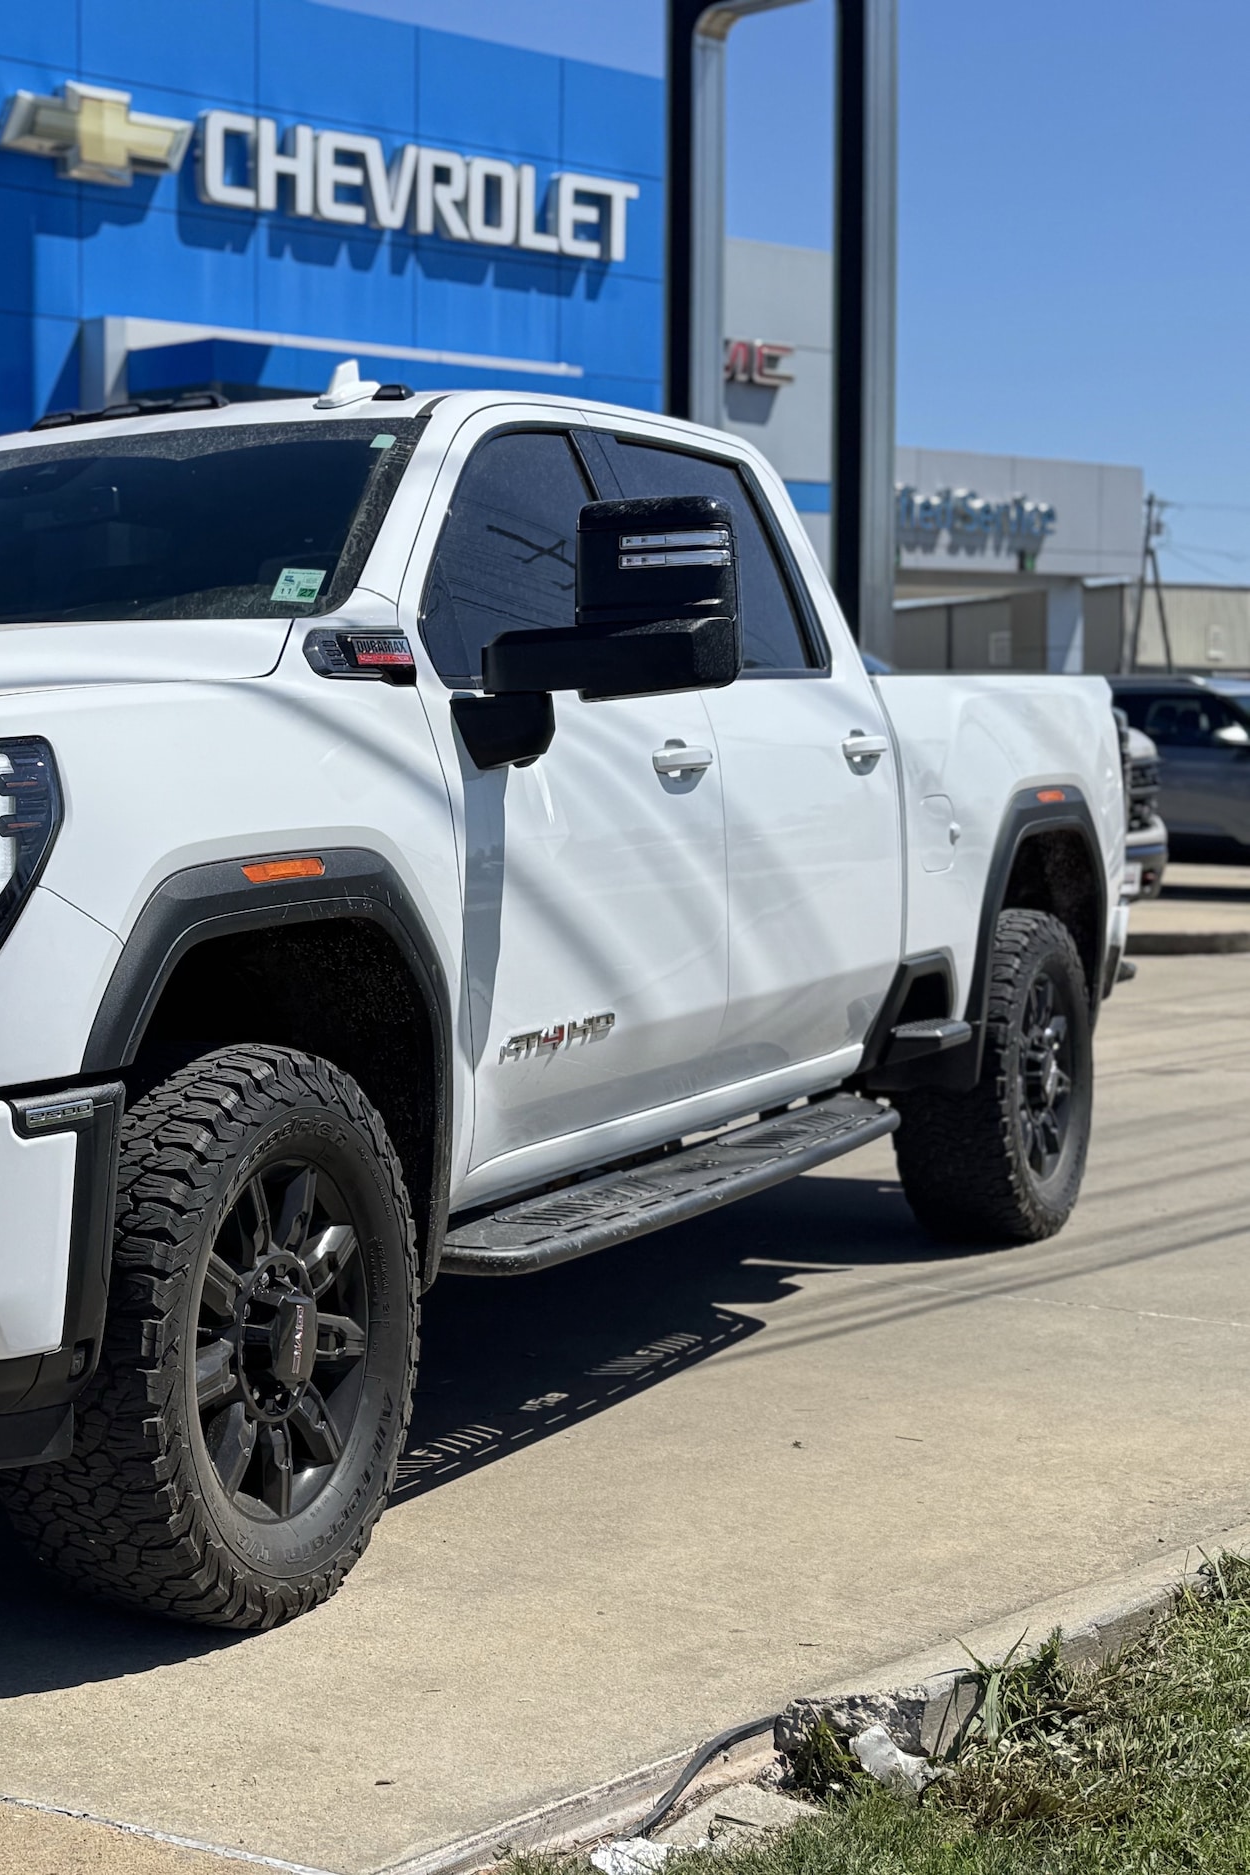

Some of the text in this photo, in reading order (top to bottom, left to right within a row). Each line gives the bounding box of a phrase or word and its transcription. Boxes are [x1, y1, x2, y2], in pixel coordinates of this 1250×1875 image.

[201, 109, 640, 262] CHEVROLET
[724, 338, 796, 384] MC
[960, 490, 1057, 536] Service
[300, 588, 316, 598] 27
[355, 640, 408, 654] DURAMAX
[29, 1104, 91, 1122] 2500
